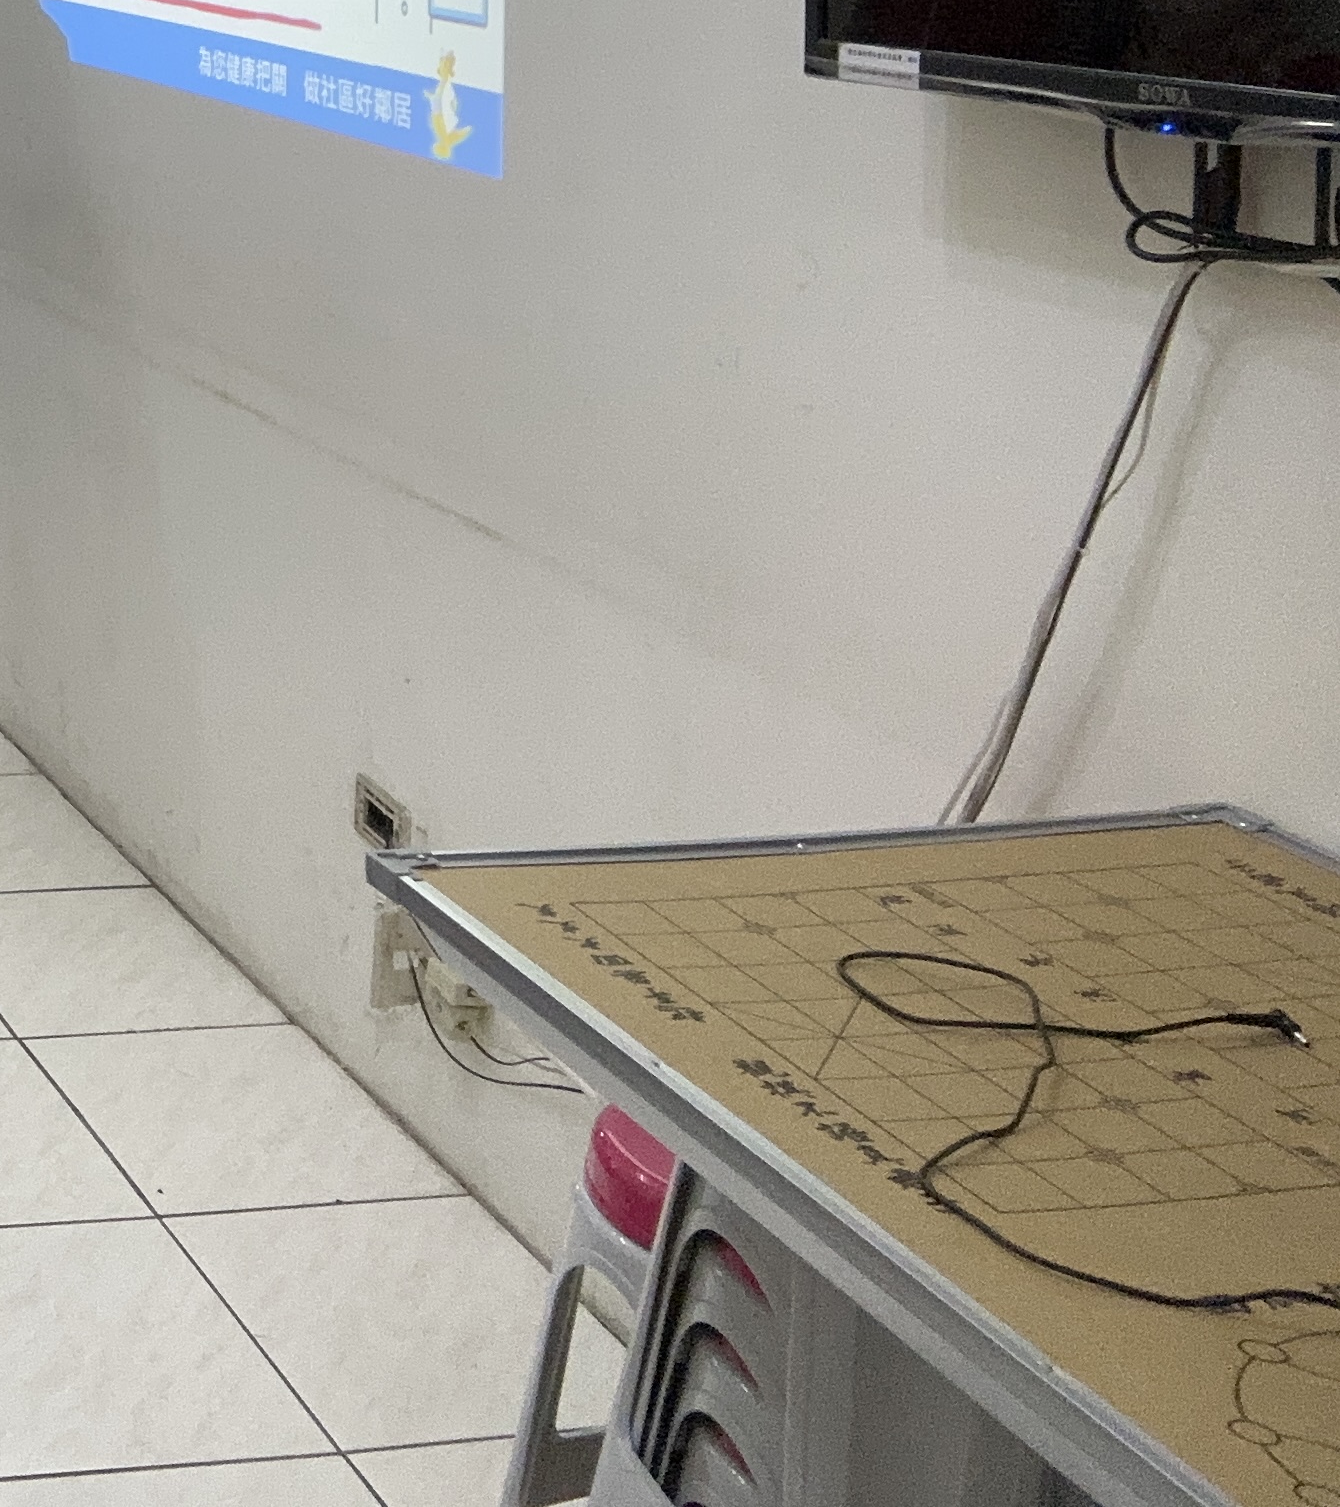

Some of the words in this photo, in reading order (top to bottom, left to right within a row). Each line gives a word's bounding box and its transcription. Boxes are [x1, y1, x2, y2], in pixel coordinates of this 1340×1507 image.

[198, 45, 288, 98] 為您健康把關
[303, 68, 412, 130] 做社區好鄰居
